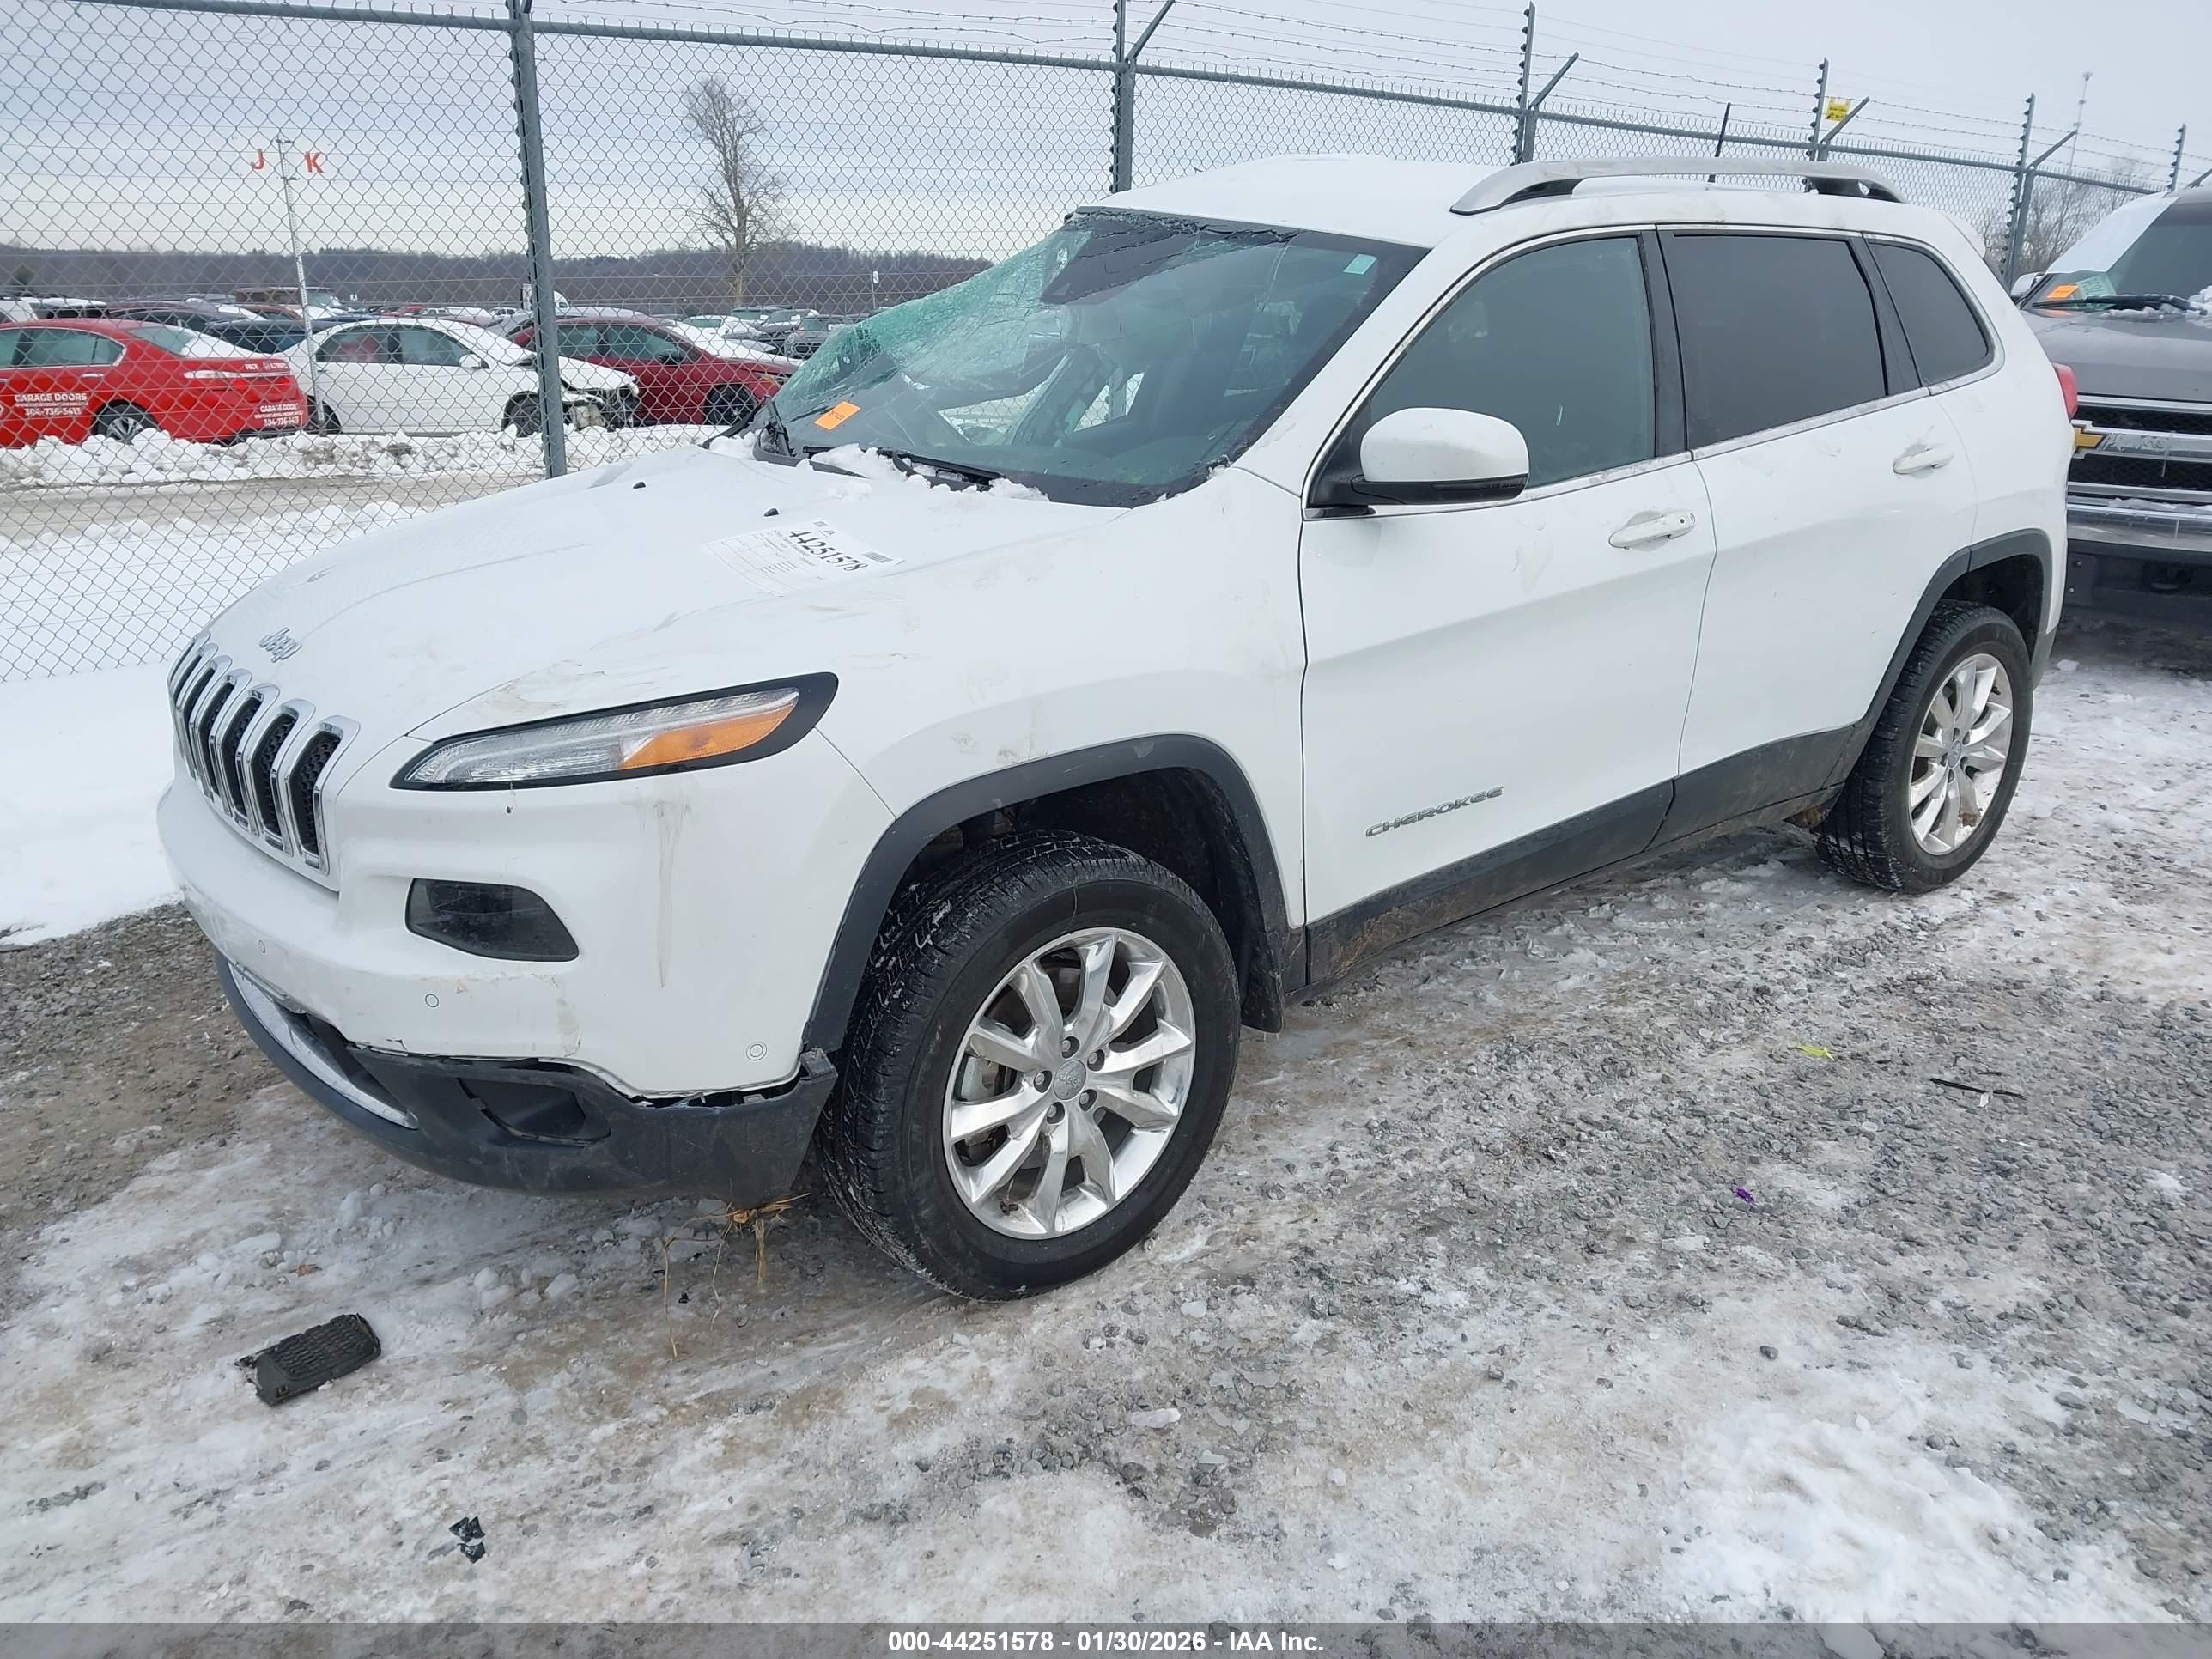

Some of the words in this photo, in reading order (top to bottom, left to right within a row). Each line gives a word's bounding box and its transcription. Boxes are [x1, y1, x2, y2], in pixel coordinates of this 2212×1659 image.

[252, 149, 264, 170] J
[304, 151, 324, 173] K
[14, 393, 52, 403] GARAGE
[54, 392, 88, 402] DOORS
[788, 530, 869, 572] 44251578
[258, 627, 303, 663] Jeep
[1365, 785, 1504, 837] CHEROKEE
